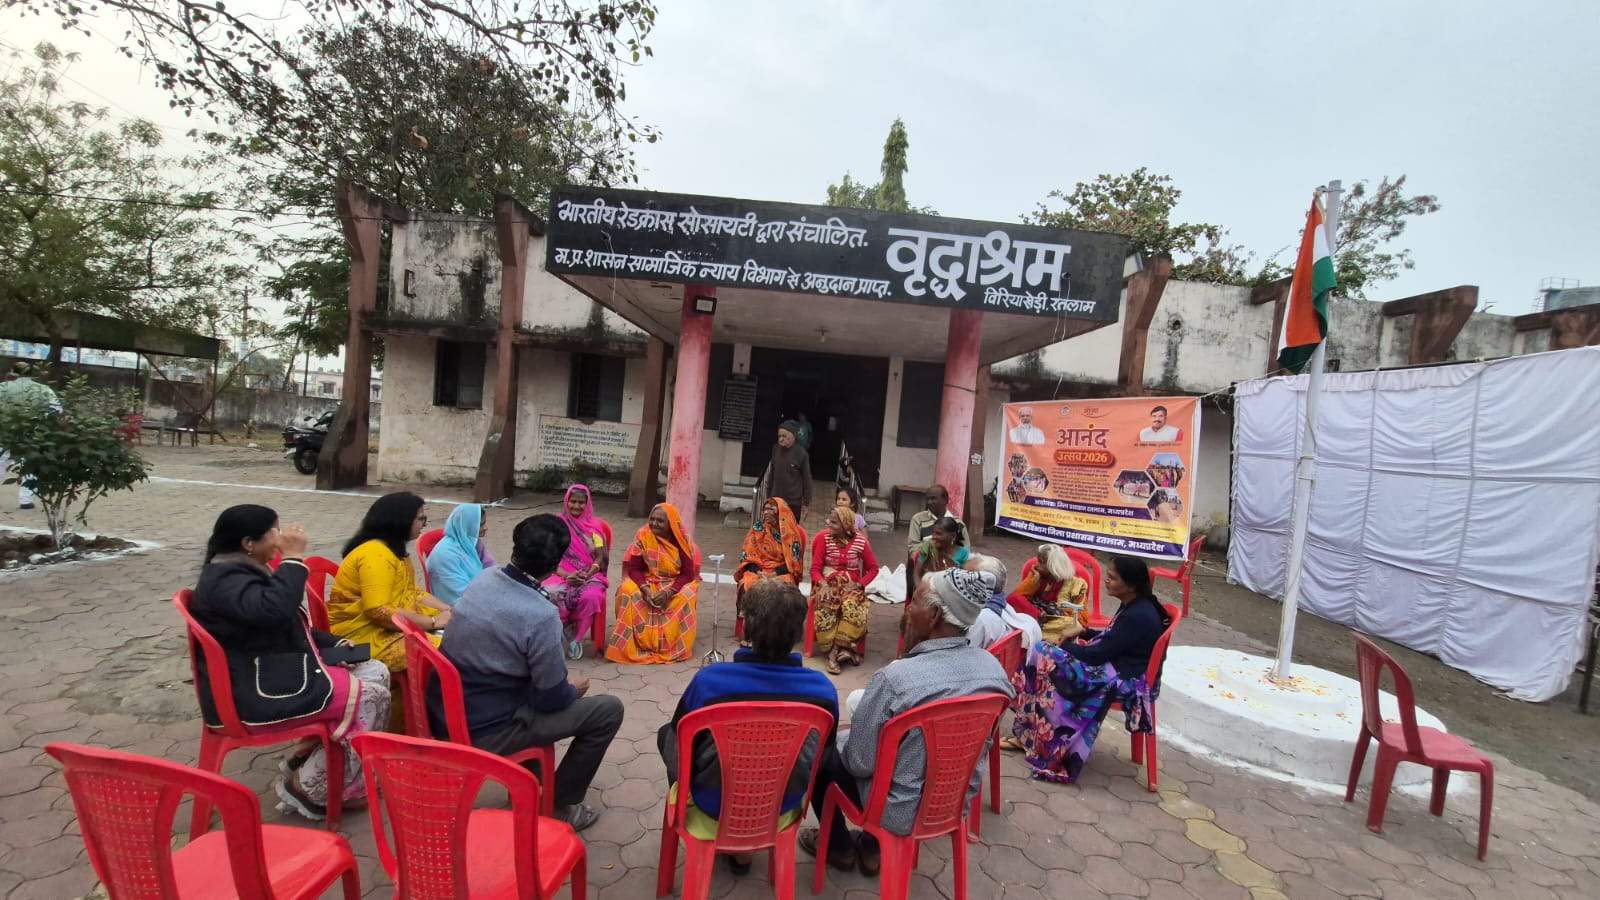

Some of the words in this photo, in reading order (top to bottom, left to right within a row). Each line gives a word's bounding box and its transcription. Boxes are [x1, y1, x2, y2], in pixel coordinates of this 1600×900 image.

[558, 198, 617, 226] भारतीय
[678, 206, 758, 236] सोसायटी
[756, 221, 787, 243] द्वारा
[627, 251, 697, 278] सामाजिक
[699, 262, 741, 281] न्याय
[742, 259, 788, 286] विभाग
[786, 266, 801, 290] से
[886, 227, 1071, 301] वृद्धाश्रम
[1049, 297, 1096, 314] रतलाम
[1057, 423, 1110, 448] आनंद
[1056, 451, 1082, 462] उत्सव
[1081, 452, 1108, 463] 2026
